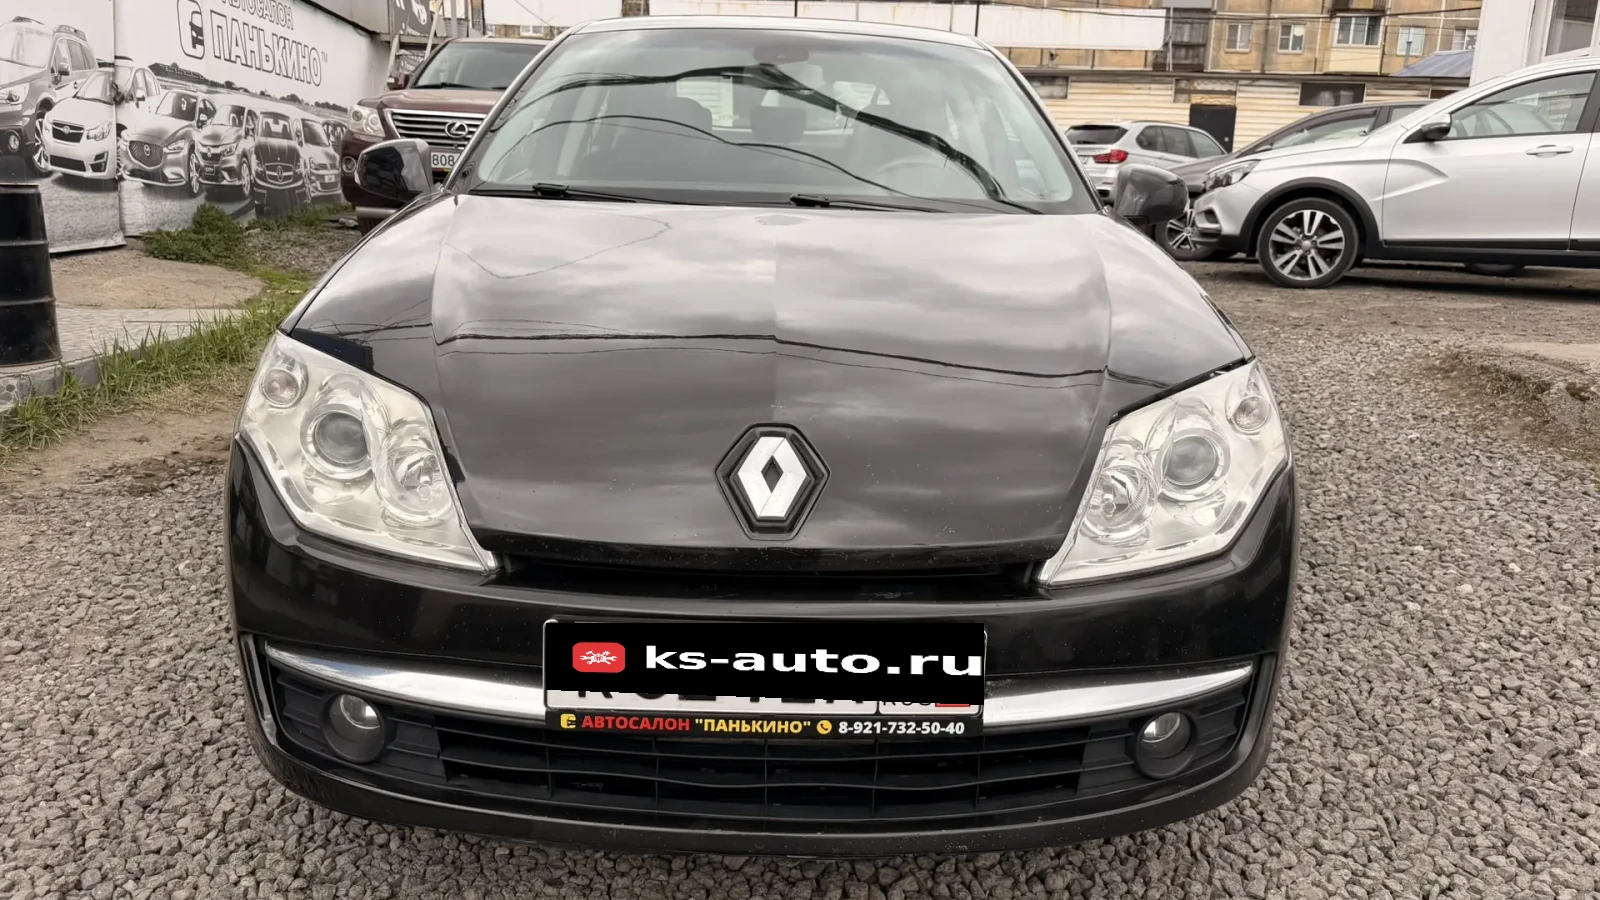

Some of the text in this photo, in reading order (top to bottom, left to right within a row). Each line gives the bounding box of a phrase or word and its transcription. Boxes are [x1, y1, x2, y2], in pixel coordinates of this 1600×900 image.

[210, 9, 322, 87] ПАНЬКИНО
[432, 154, 455, 167] 808
[581, 715, 965, 735] АВТОСАЛОН "ПАНЬКИНО" 8-921-732-50-40
